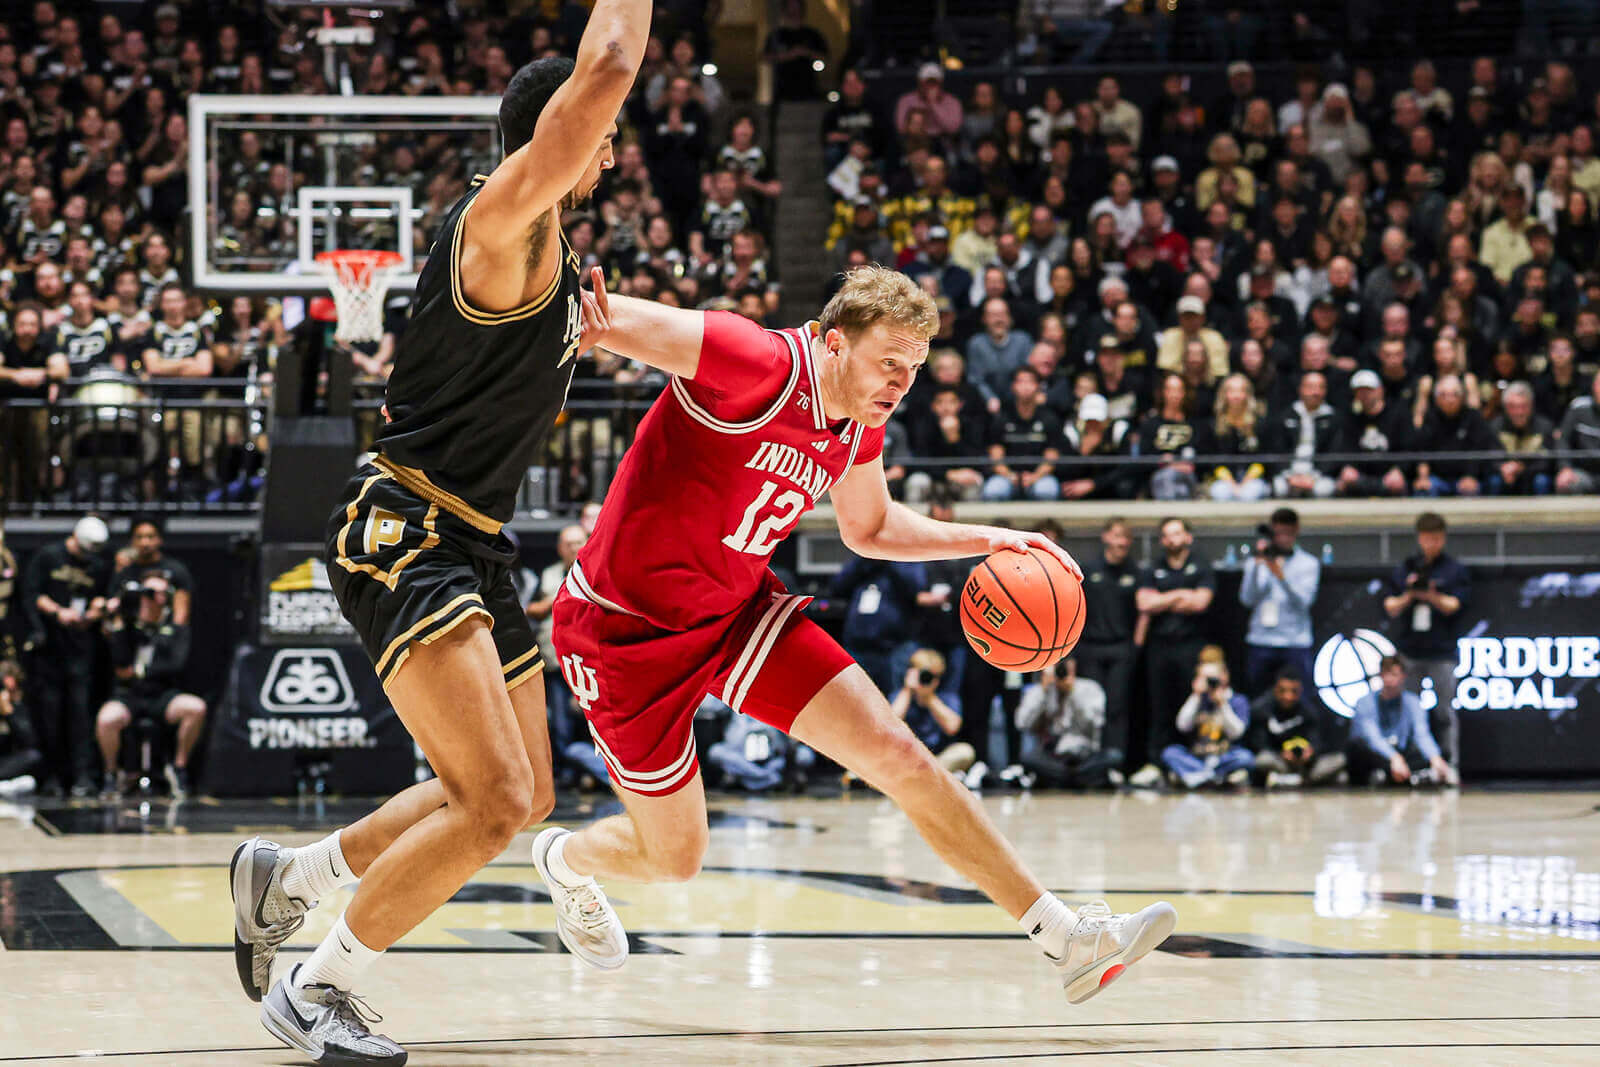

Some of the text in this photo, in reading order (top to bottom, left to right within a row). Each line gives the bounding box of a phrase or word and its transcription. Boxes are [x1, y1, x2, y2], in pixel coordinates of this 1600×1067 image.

[744, 441, 833, 504] INDIAN
[721, 480, 805, 556] 12
[966, 576, 1008, 630] ELITE
[1454, 637, 1600, 677] RDUE
[1420, 677, 1572, 710] OBAL
